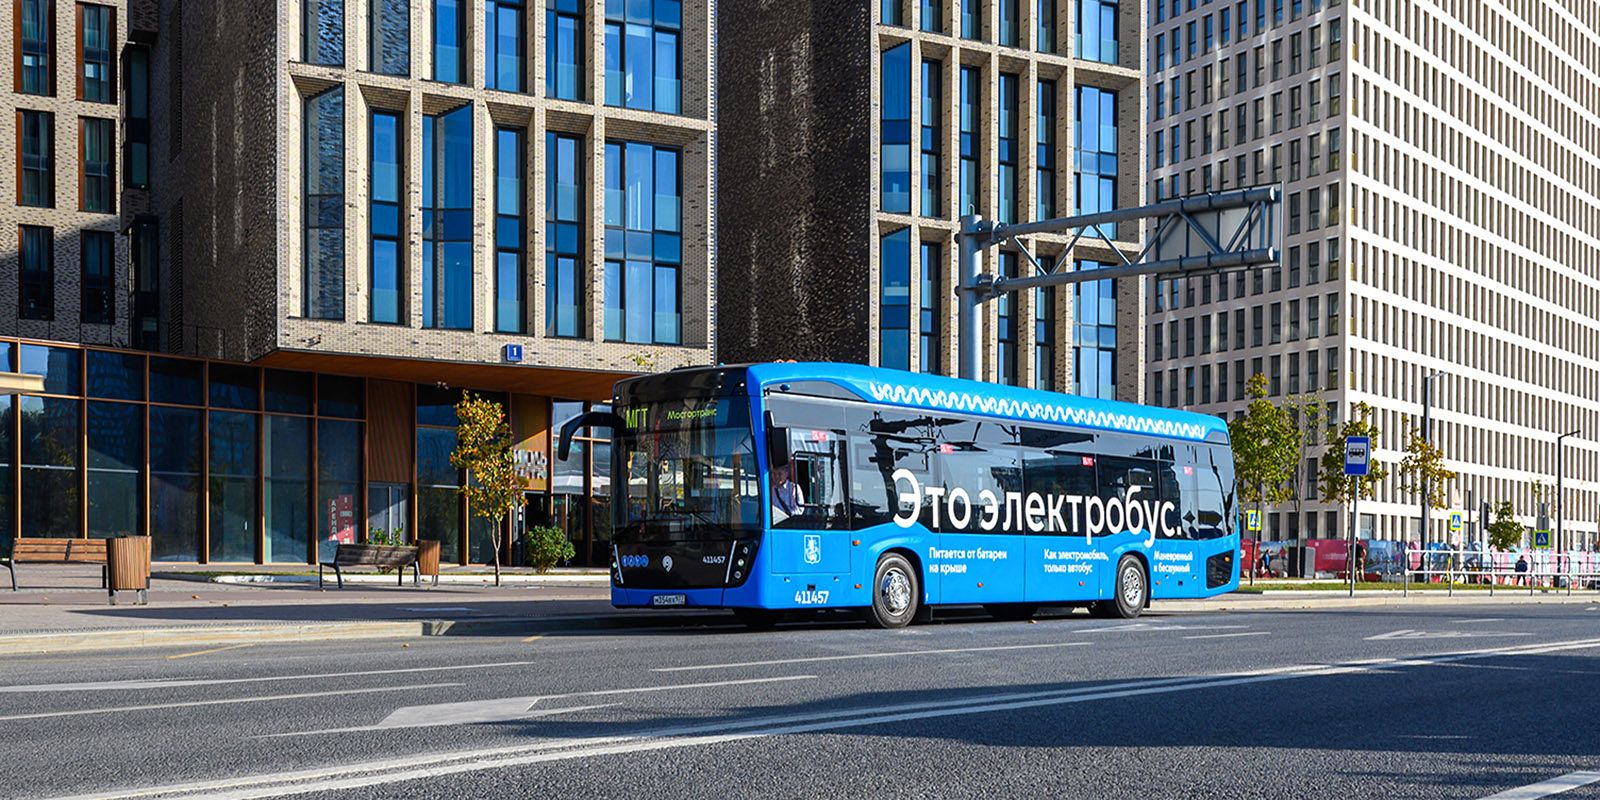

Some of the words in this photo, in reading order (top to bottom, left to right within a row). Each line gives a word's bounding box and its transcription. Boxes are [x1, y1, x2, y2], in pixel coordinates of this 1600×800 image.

[626, 408, 648, 428] МГТ
[667, 408, 717, 420] Мосгортранс
[891, 468, 971, 529] Это
[979, 485, 1181, 548] электробус.
[702, 556, 726, 564] 411457
[929, 546, 966, 559] Питается
[966, 550, 976, 559] от
[976, 547, 1008, 562] батареи
[1044, 548, 1057, 560] Как
[929, 564, 939, 573] на
[940, 564, 968, 576] крыше
[1044, 564, 1067, 573] только
[1067, 561, 1093, 575] автобус
[794, 590, 830, 605] 411457
